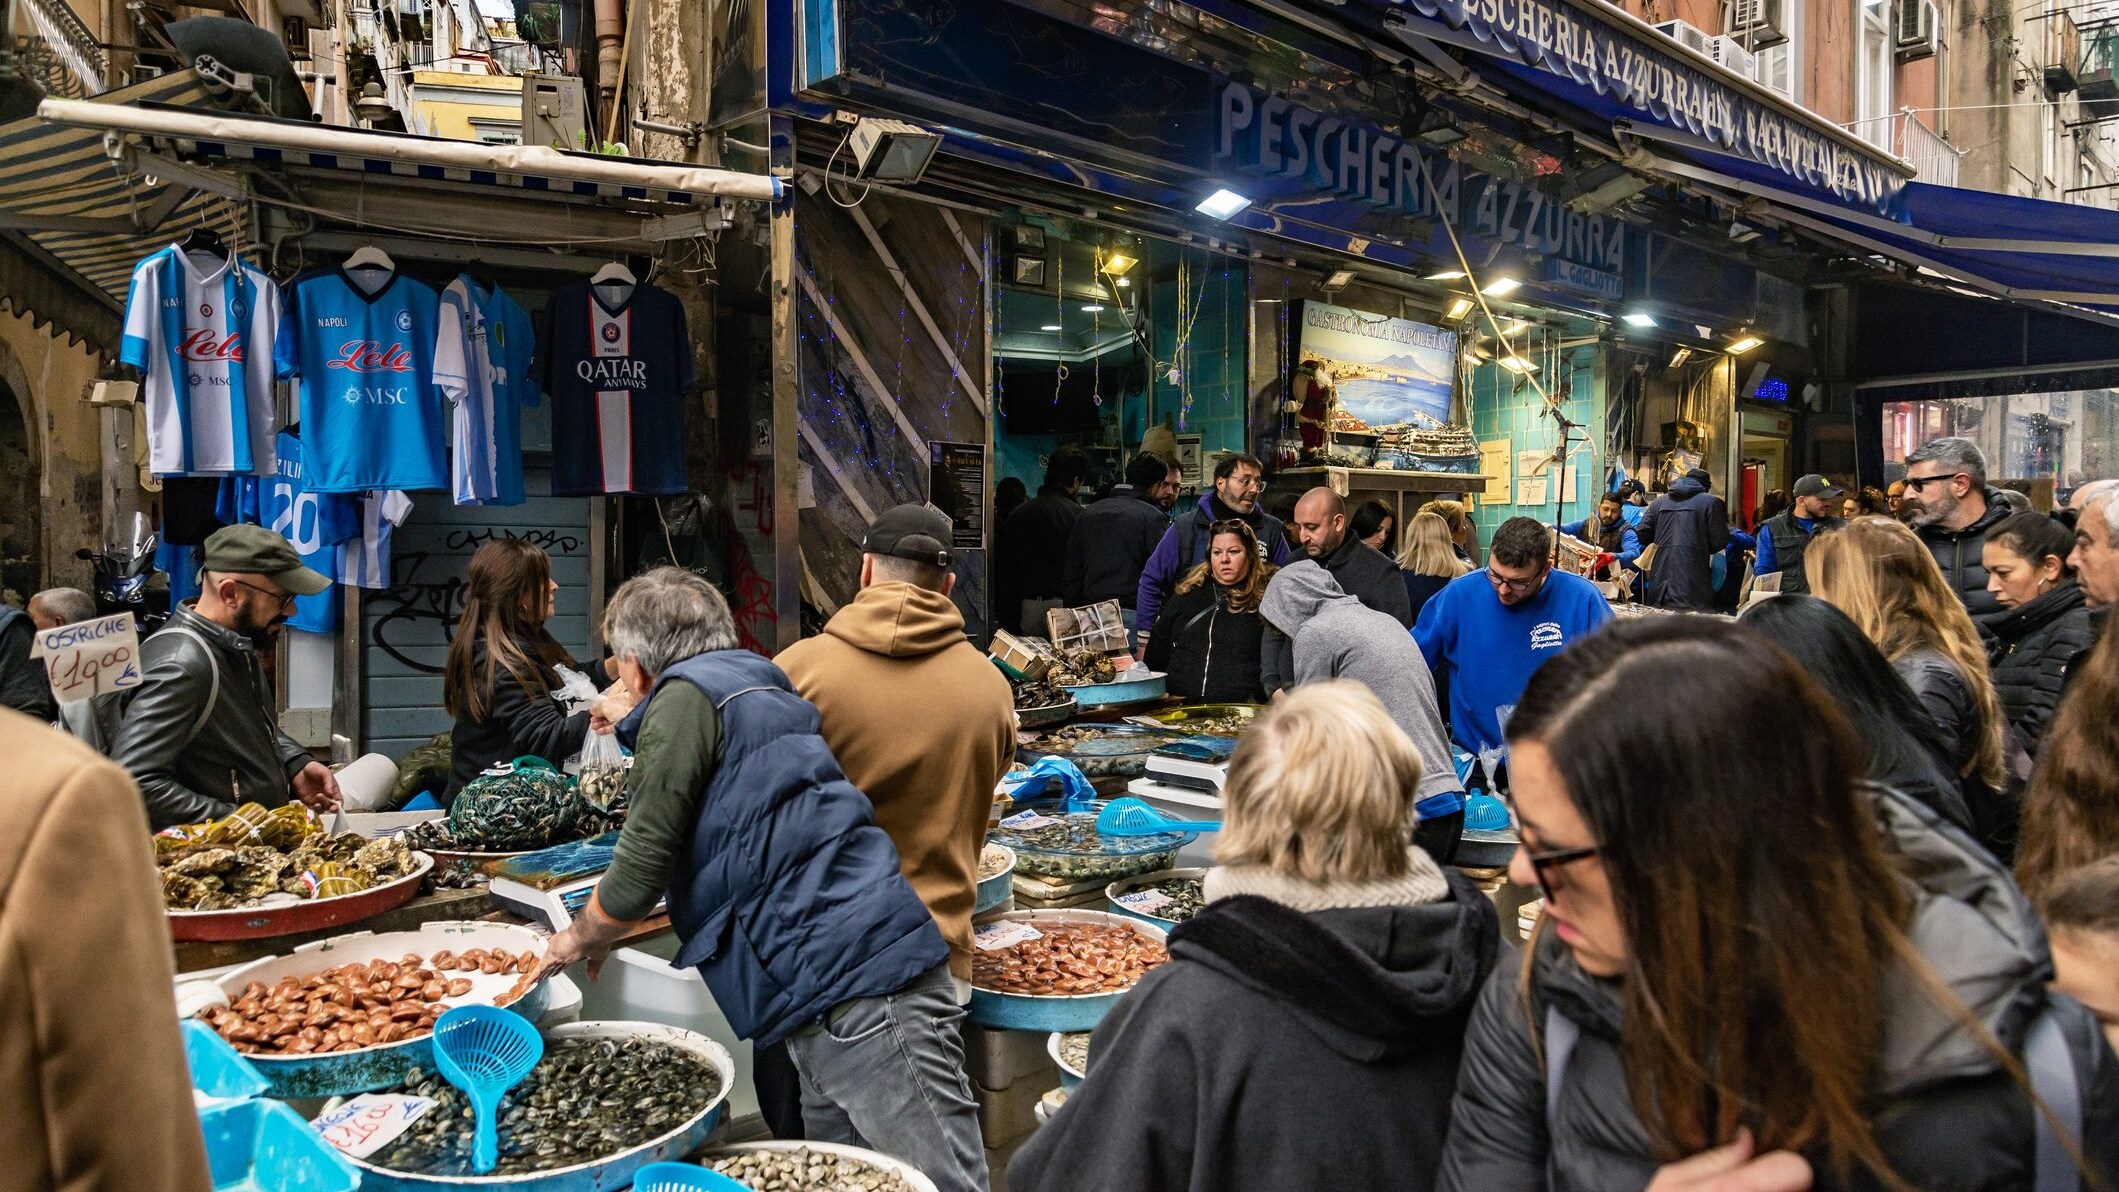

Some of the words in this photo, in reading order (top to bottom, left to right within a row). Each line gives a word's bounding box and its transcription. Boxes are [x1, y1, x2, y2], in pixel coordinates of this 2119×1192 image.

[1604, 40, 1702, 120] AZZURRA
[1221, 81, 1459, 225] PESCHERIA
[1476, 172, 1625, 273] AZZURRA
[318, 317, 348, 328] NAPOLI
[1307, 307, 1389, 341] GASTRONOMIA
[1390, 321, 1456, 354] NAPOLETANA
[576, 358, 647, 383] QATAR
[365, 386, 409, 405] MSC
[271, 482, 321, 556] 20
